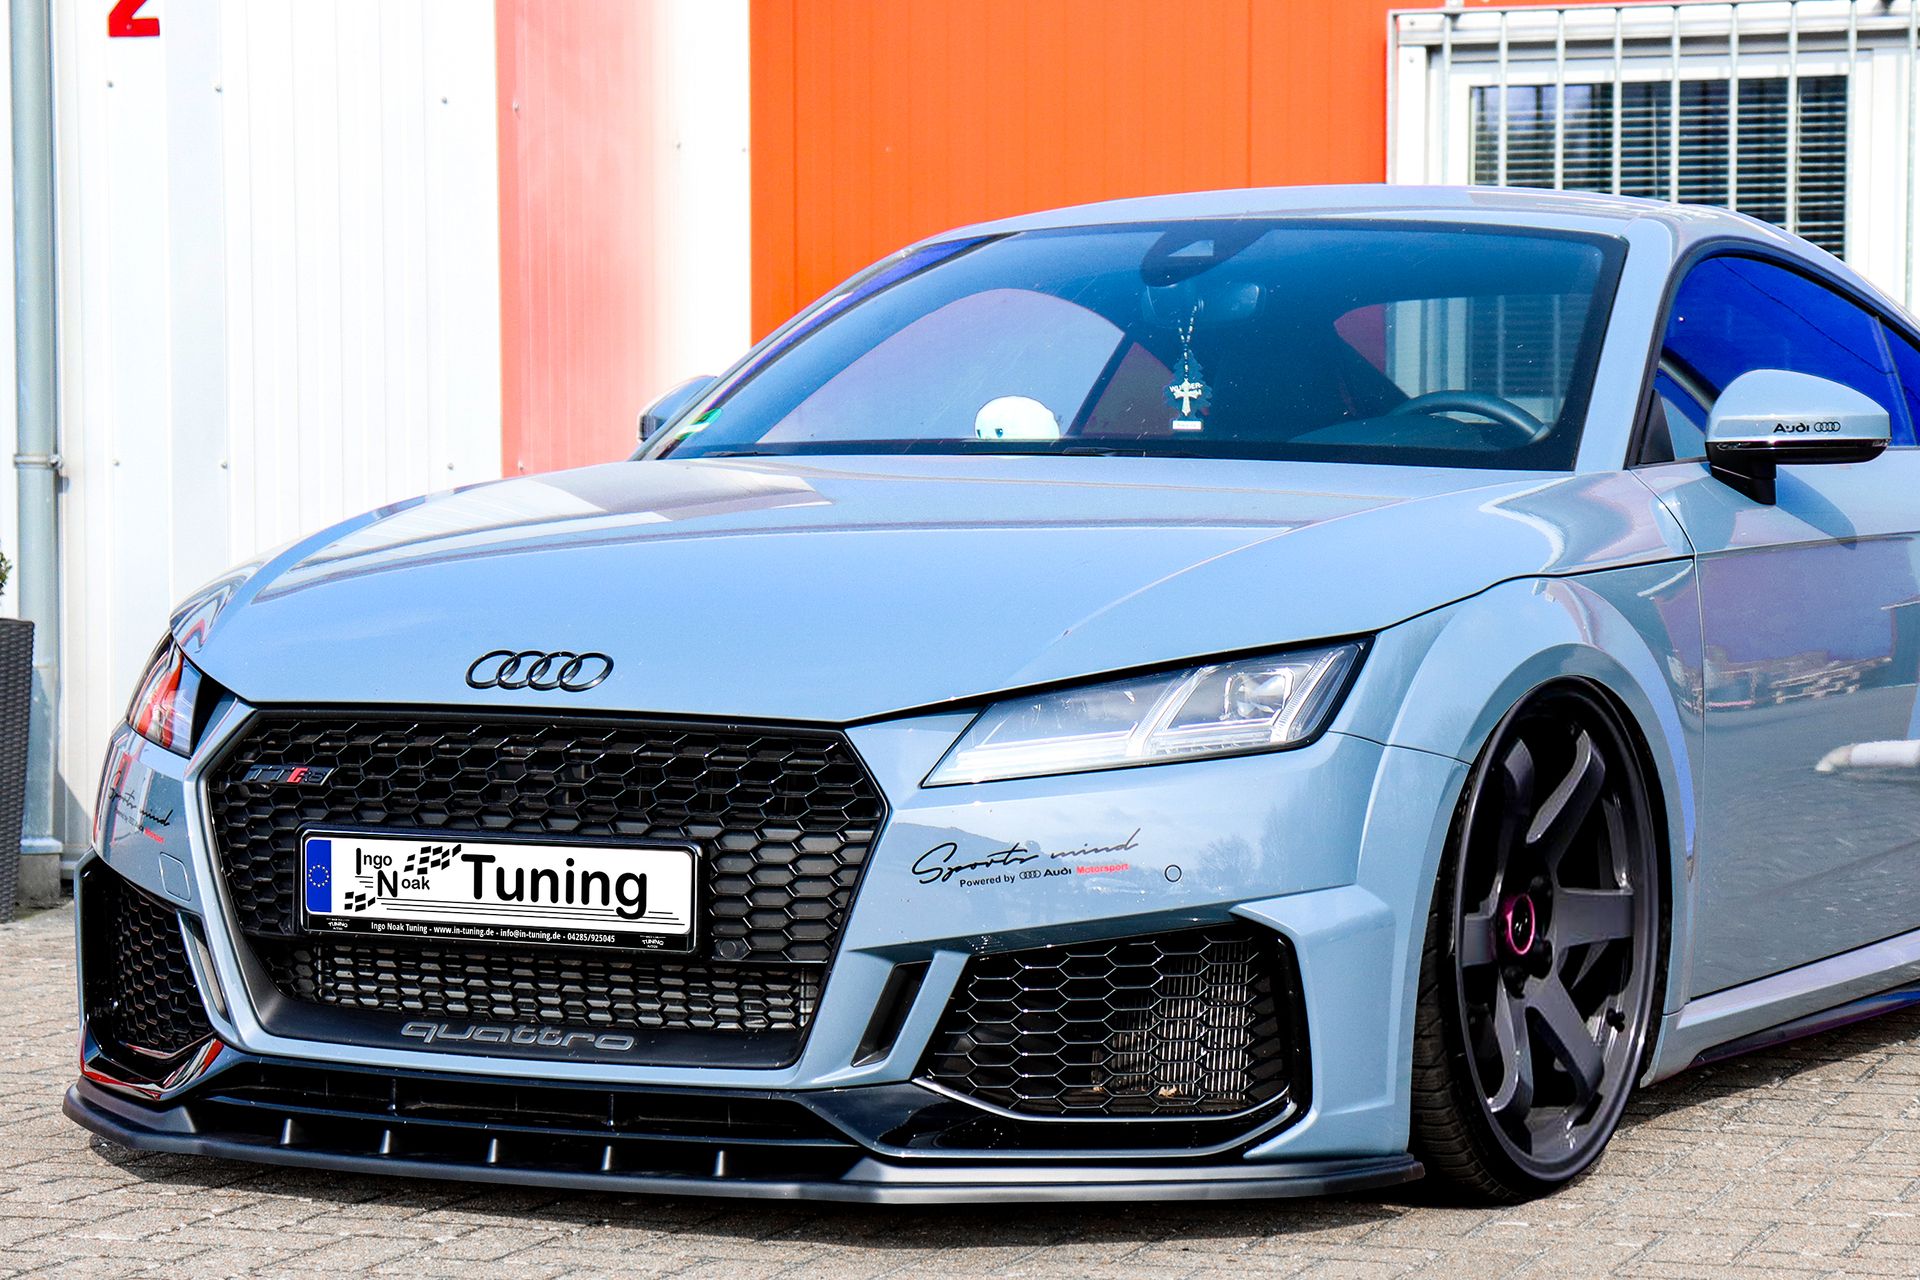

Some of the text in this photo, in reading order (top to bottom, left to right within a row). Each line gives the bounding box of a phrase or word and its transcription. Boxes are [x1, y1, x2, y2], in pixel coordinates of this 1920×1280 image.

[1773, 422, 1810, 433] Audi
[355, 847, 393, 875] Ingo
[912, 827, 1141, 884] Sports mind
[376, 869, 431, 898] Noak
[460, 853, 648, 920] Tuning
[959, 863, 1129, 888] Powered by Audi Motorsport
[371, 922, 386, 932] Ingo
[386, 922, 405, 932] Noak
[406, 924, 428, 935] Tuning
[433, 925, 494, 938] www.in-tuning.de
[500, 929, 561, 942] info@in-tuning.de
[567, 932, 616, 944] 04285/925045
[401, 1021, 635, 1051] quattro
